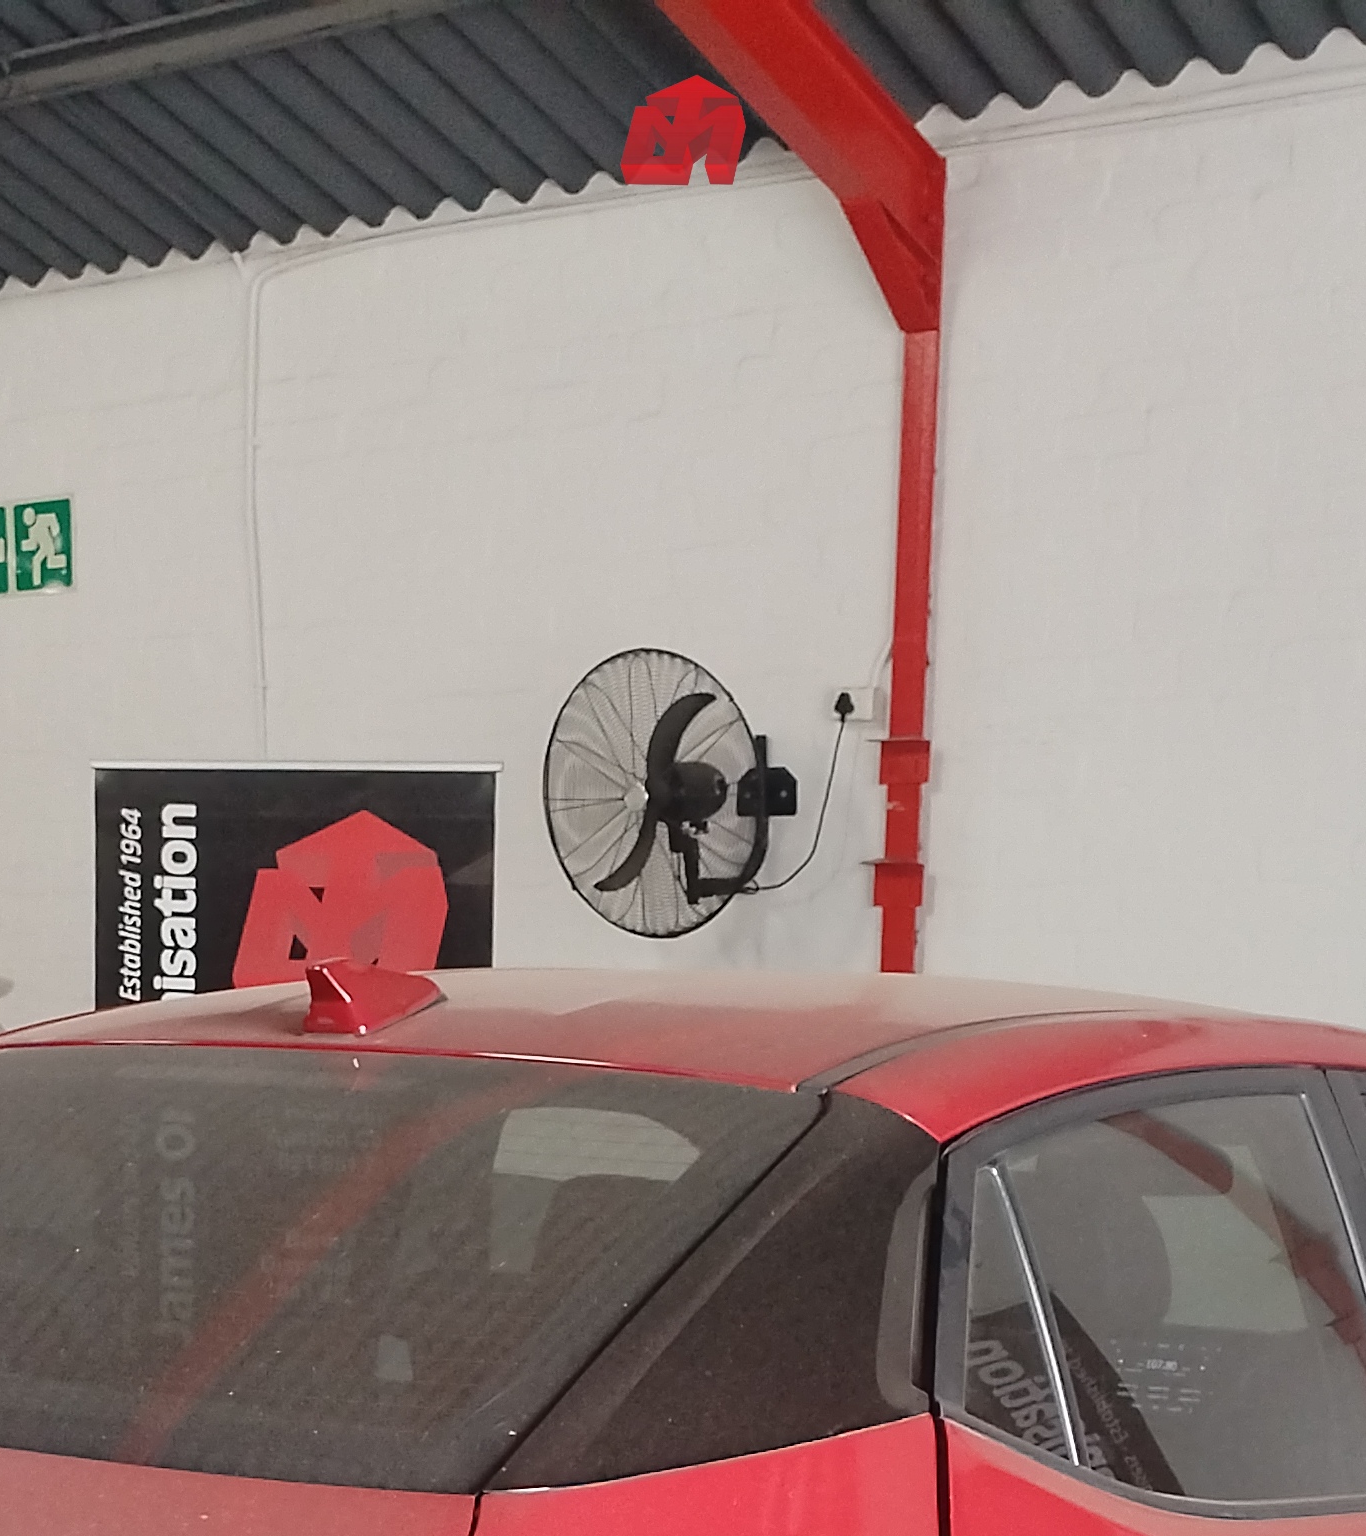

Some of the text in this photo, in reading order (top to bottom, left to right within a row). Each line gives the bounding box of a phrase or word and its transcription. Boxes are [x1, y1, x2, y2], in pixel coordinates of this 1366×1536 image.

[118, 807, 142, 1002] Established 1964
[153, 803, 198, 1001] isation
